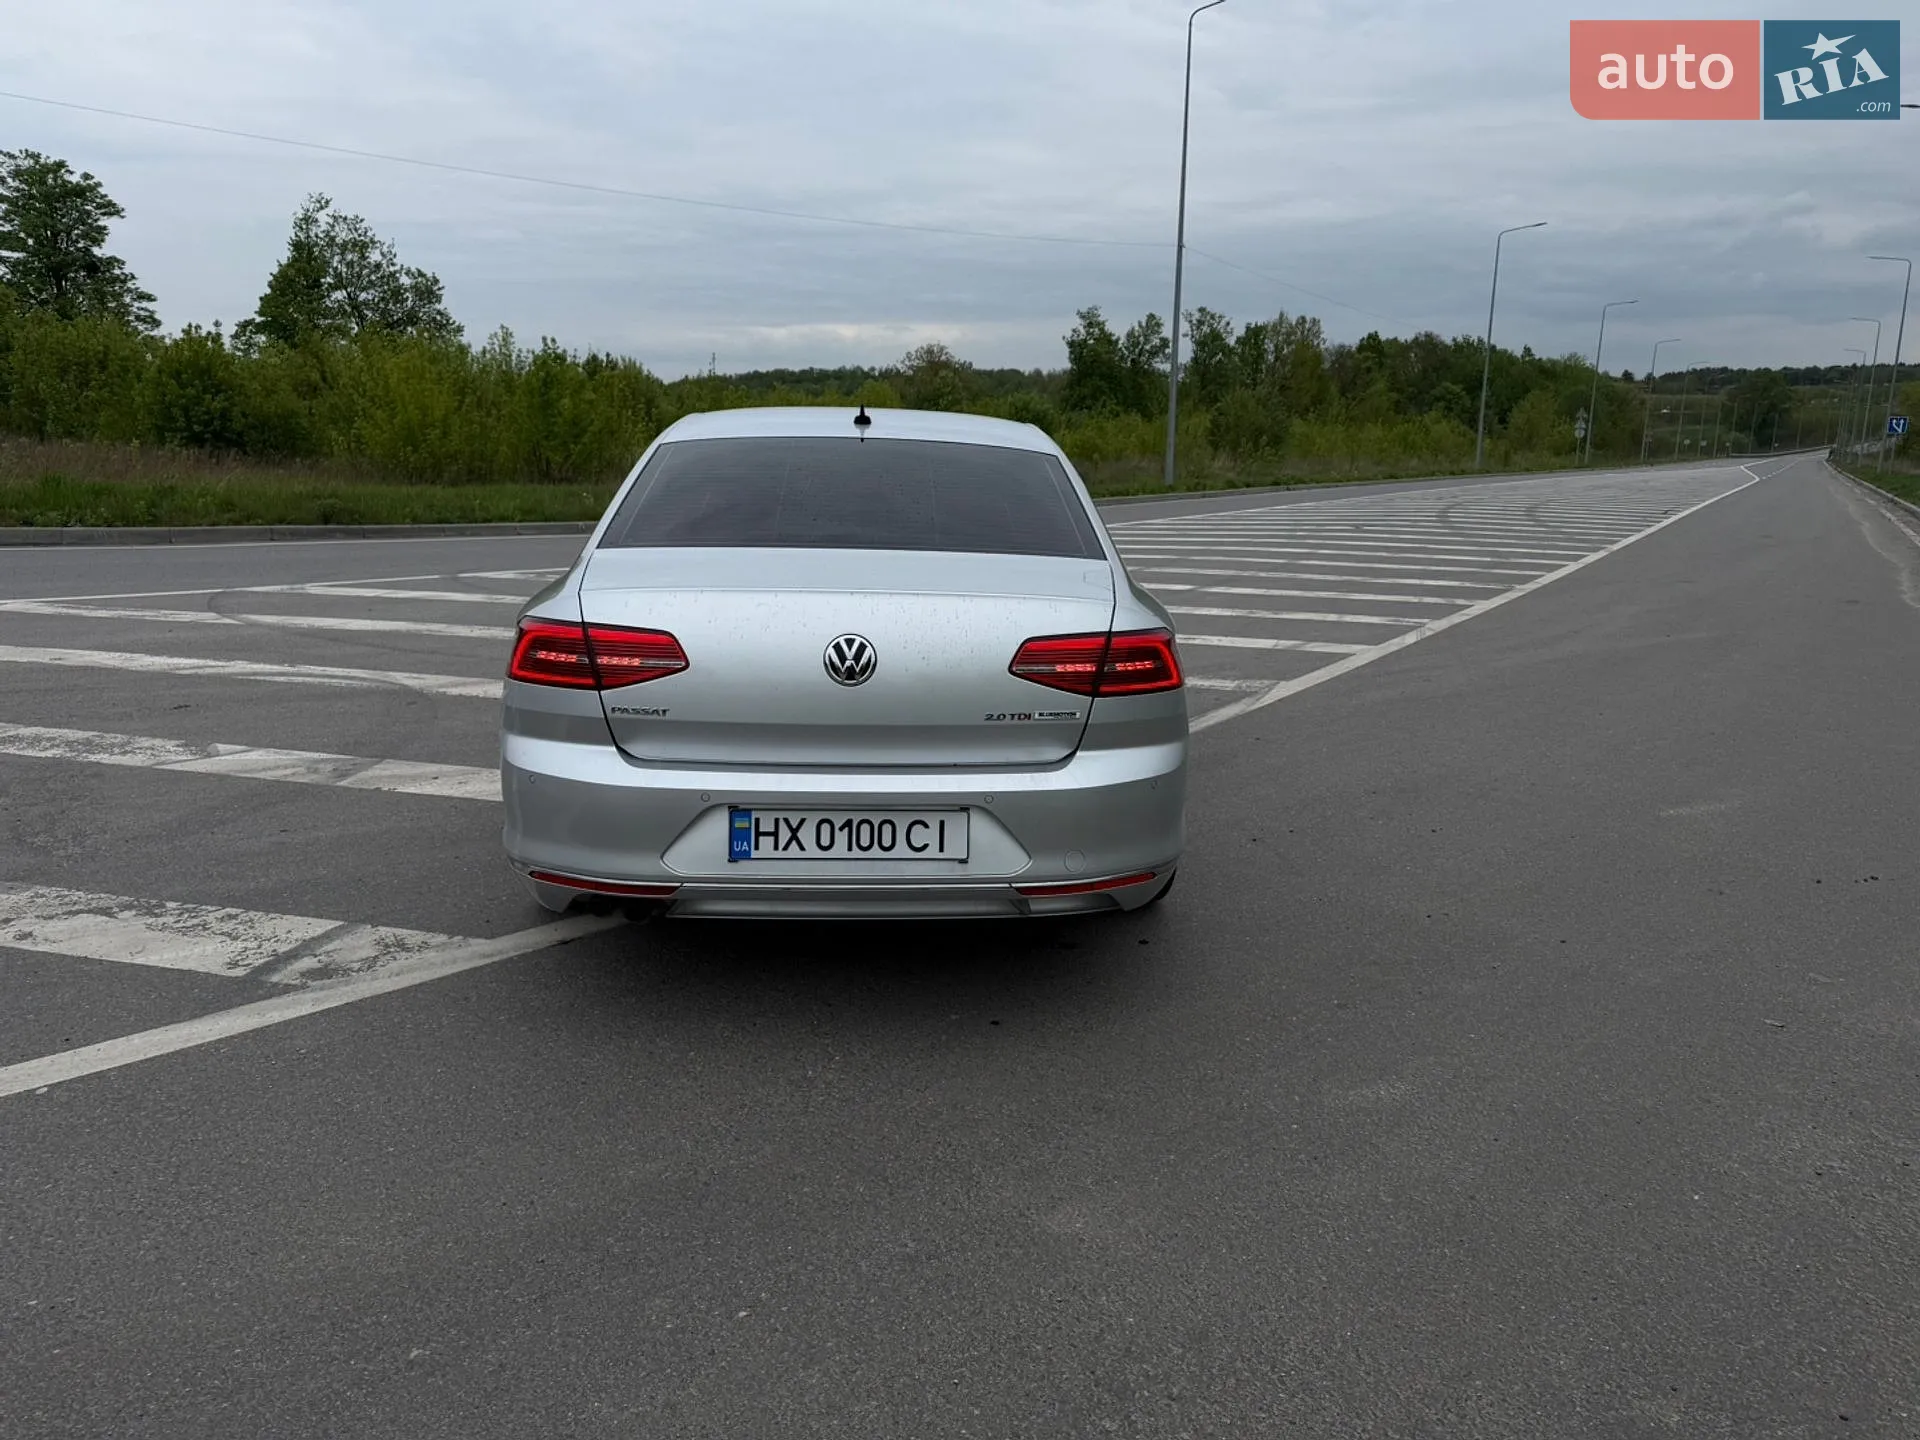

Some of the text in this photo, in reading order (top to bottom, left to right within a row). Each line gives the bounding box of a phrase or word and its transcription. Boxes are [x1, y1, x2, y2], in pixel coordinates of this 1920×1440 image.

[611, 705, 670, 717] PASSAT
[984, 712, 1006, 721] 2.0
[1008, 712, 1031, 721] TDI
[754, 817, 946, 853] HX 0100 CI
[733, 840, 749, 852] UA
